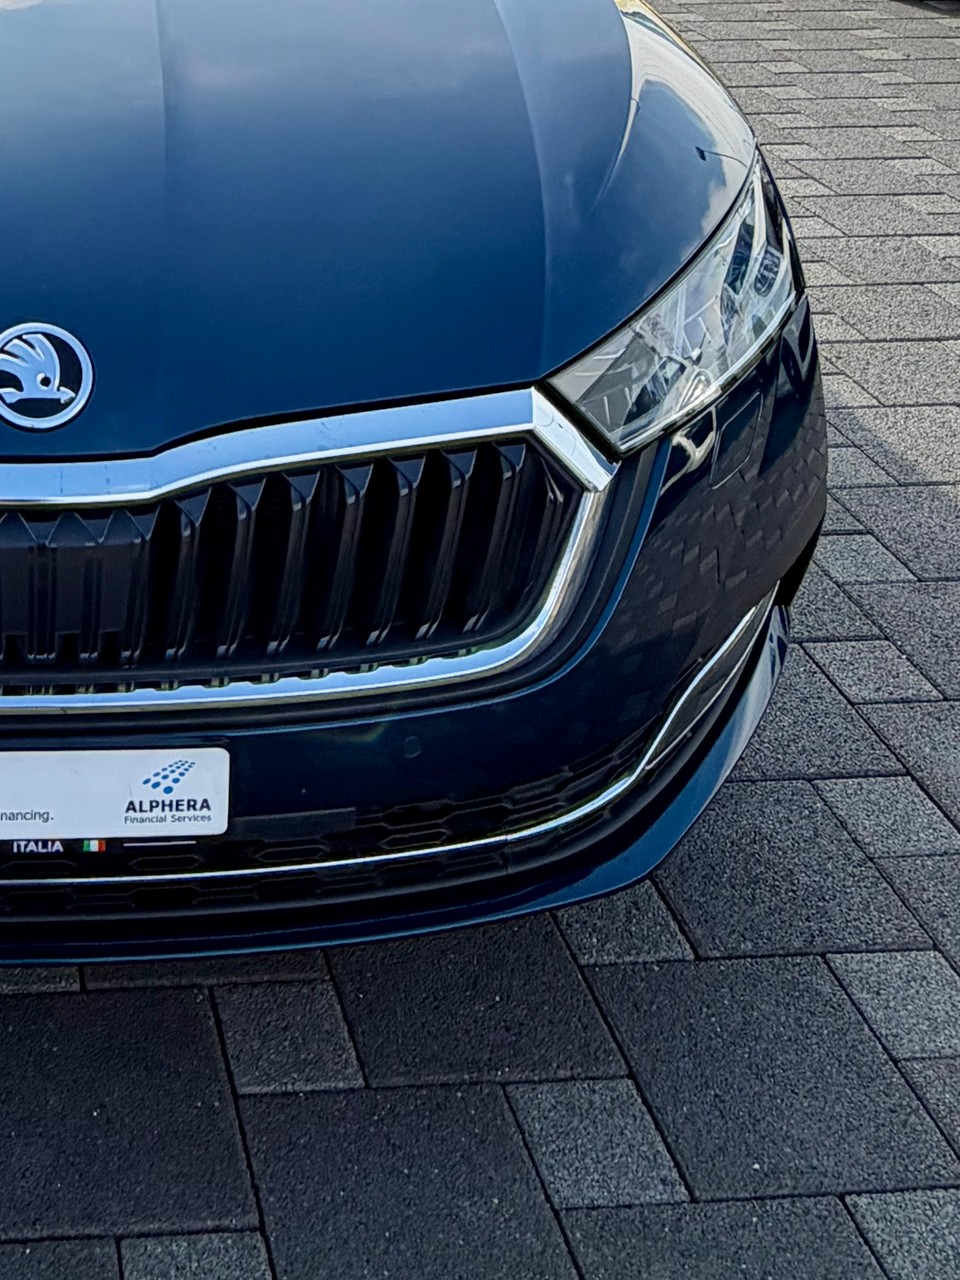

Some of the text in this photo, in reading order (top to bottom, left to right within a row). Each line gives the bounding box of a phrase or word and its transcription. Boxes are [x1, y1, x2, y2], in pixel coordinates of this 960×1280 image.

[124, 798, 212, 814] ALPHERA
[124, 813, 212, 824] Financial Services
[12, 840, 64, 854] ITALIA
